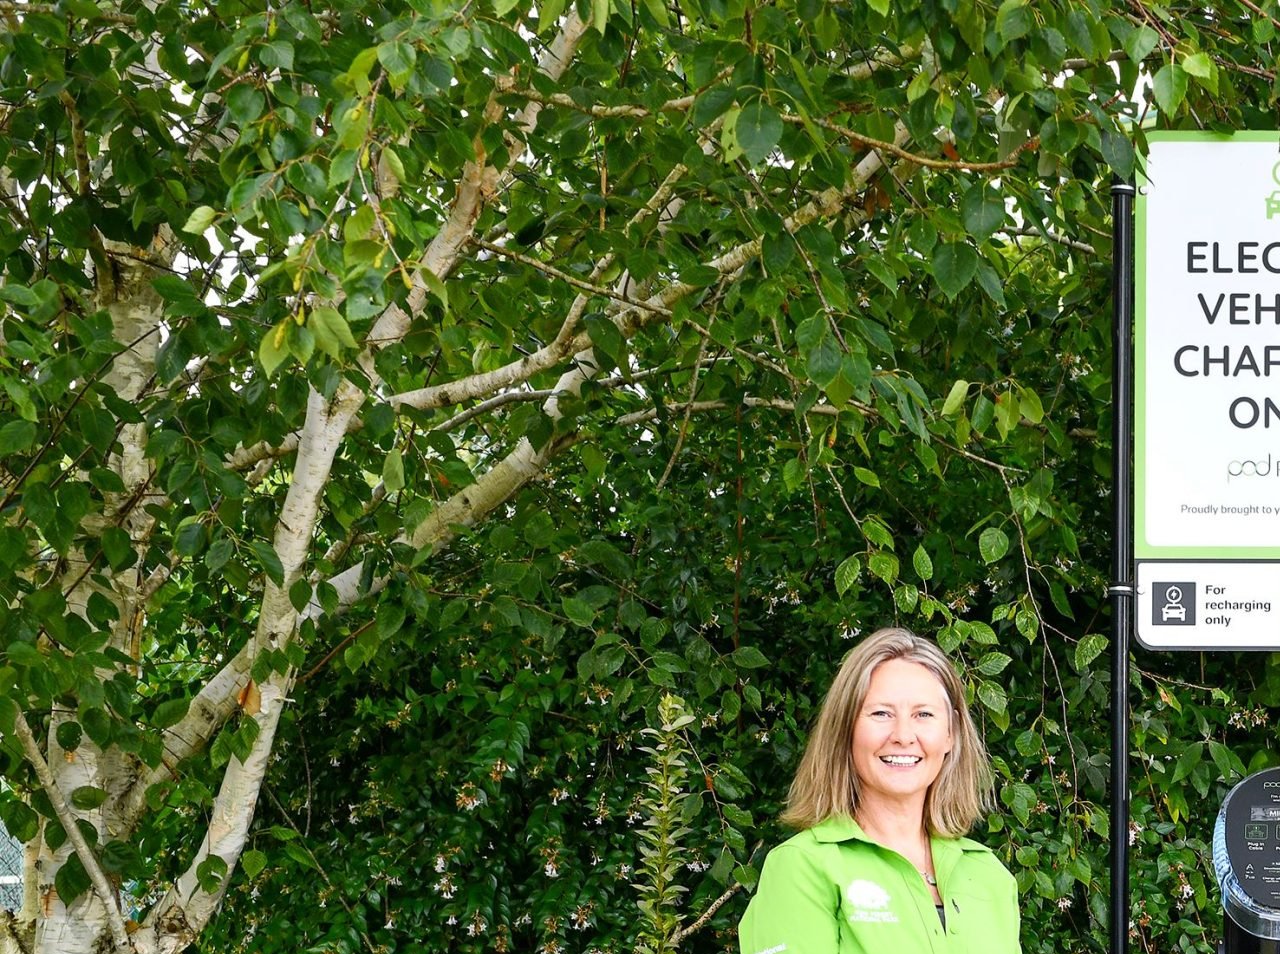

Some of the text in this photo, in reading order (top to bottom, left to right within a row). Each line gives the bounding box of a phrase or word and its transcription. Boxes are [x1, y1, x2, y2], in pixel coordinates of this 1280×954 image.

[1227, 452, 1271, 483] pod
[1180, 504, 1219, 516] Proudly
[1220, 504, 1259, 516] brought
[1261, 505, 1272, 515] to
[1205, 584, 1226, 596] For
[1205, 600, 1271, 613] recharging
[1205, 615, 1232, 628] only
[1246, 863, 1254, 871] A
